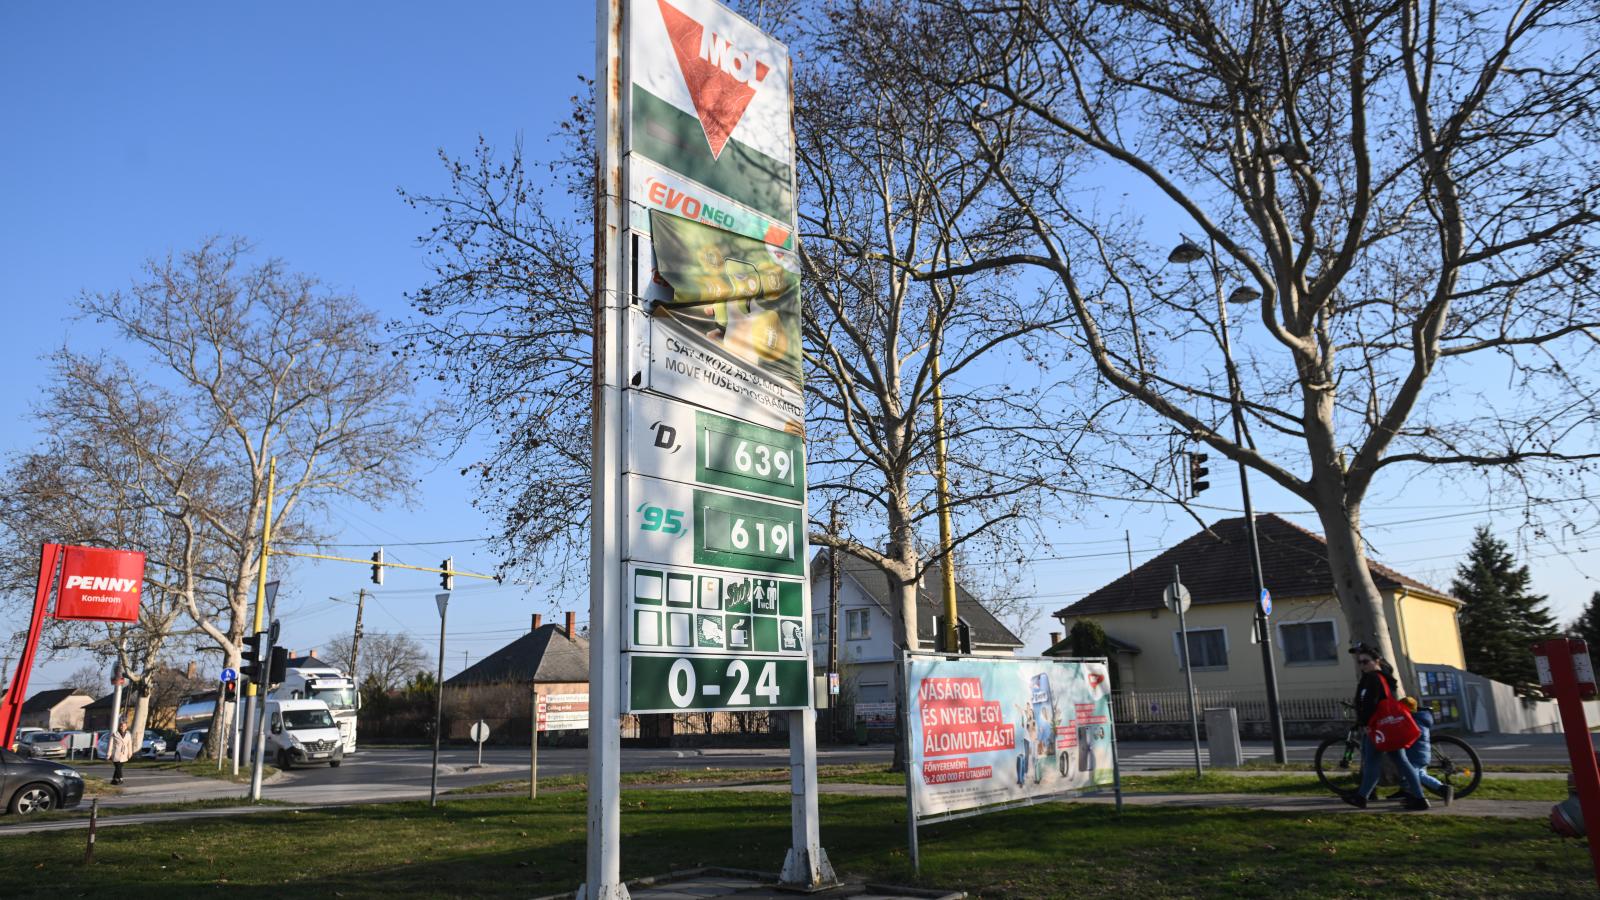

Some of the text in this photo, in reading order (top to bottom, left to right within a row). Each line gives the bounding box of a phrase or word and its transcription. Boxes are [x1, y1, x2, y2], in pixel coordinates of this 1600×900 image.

[699, 25, 764, 92] MOL
[701, 203, 735, 228] NEO
[665, 357, 700, 379] MOVE
[734, 441, 790, 479] 639
[731, 518, 788, 554] 619
[81, 594, 121, 603] Komárom
[920, 678, 981, 700] VÁSÁROLJ
[922, 704, 1000, 726] ÉS NYERJ EGY
[925, 726, 1014, 752] ÁLOMUTAZÁST!
